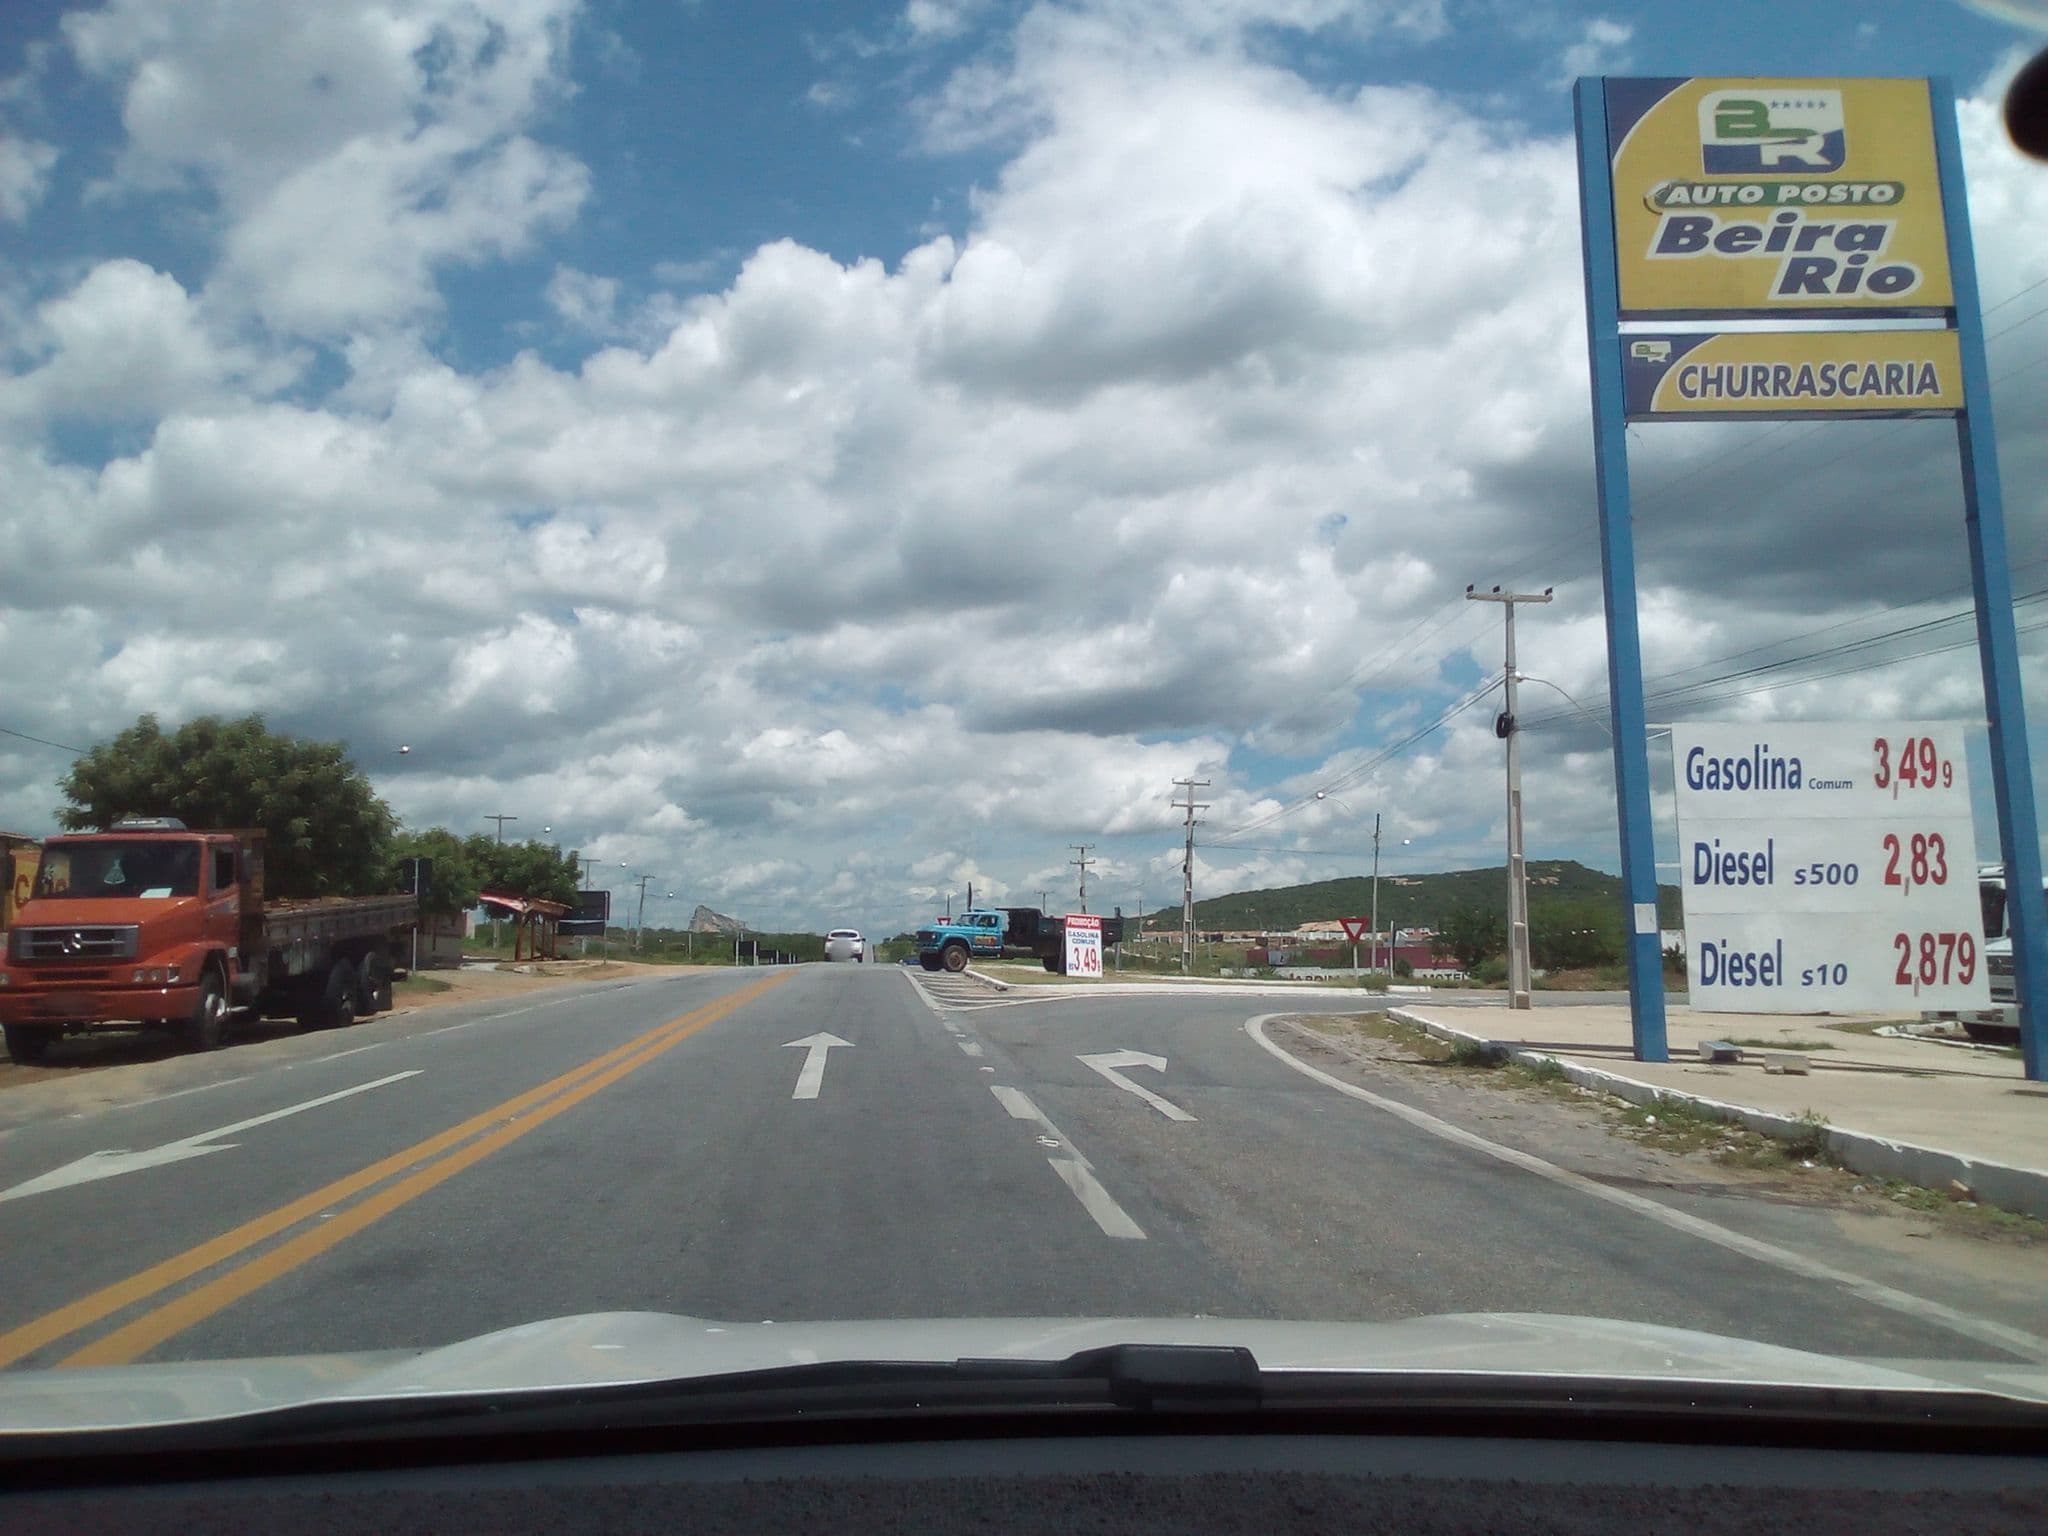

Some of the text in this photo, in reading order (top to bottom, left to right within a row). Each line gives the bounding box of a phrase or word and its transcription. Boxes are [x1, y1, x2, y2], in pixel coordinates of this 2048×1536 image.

[1664, 182, 1895, 205] AUTO POSTO
[1655, 211, 1888, 255] Beira
[1777, 252, 1916, 295] Rio
[1677, 361, 1941, 399] CHURRASCARIA
[1686, 744, 1802, 791] Gasolina
[1808, 777, 1853, 791] Comum
[1693, 838, 1774, 886] Diesel
[1883, 833, 1948, 897] 2,83
[1700, 938, 1783, 987] Diesel
[1894, 932, 1976, 997] 2,879
